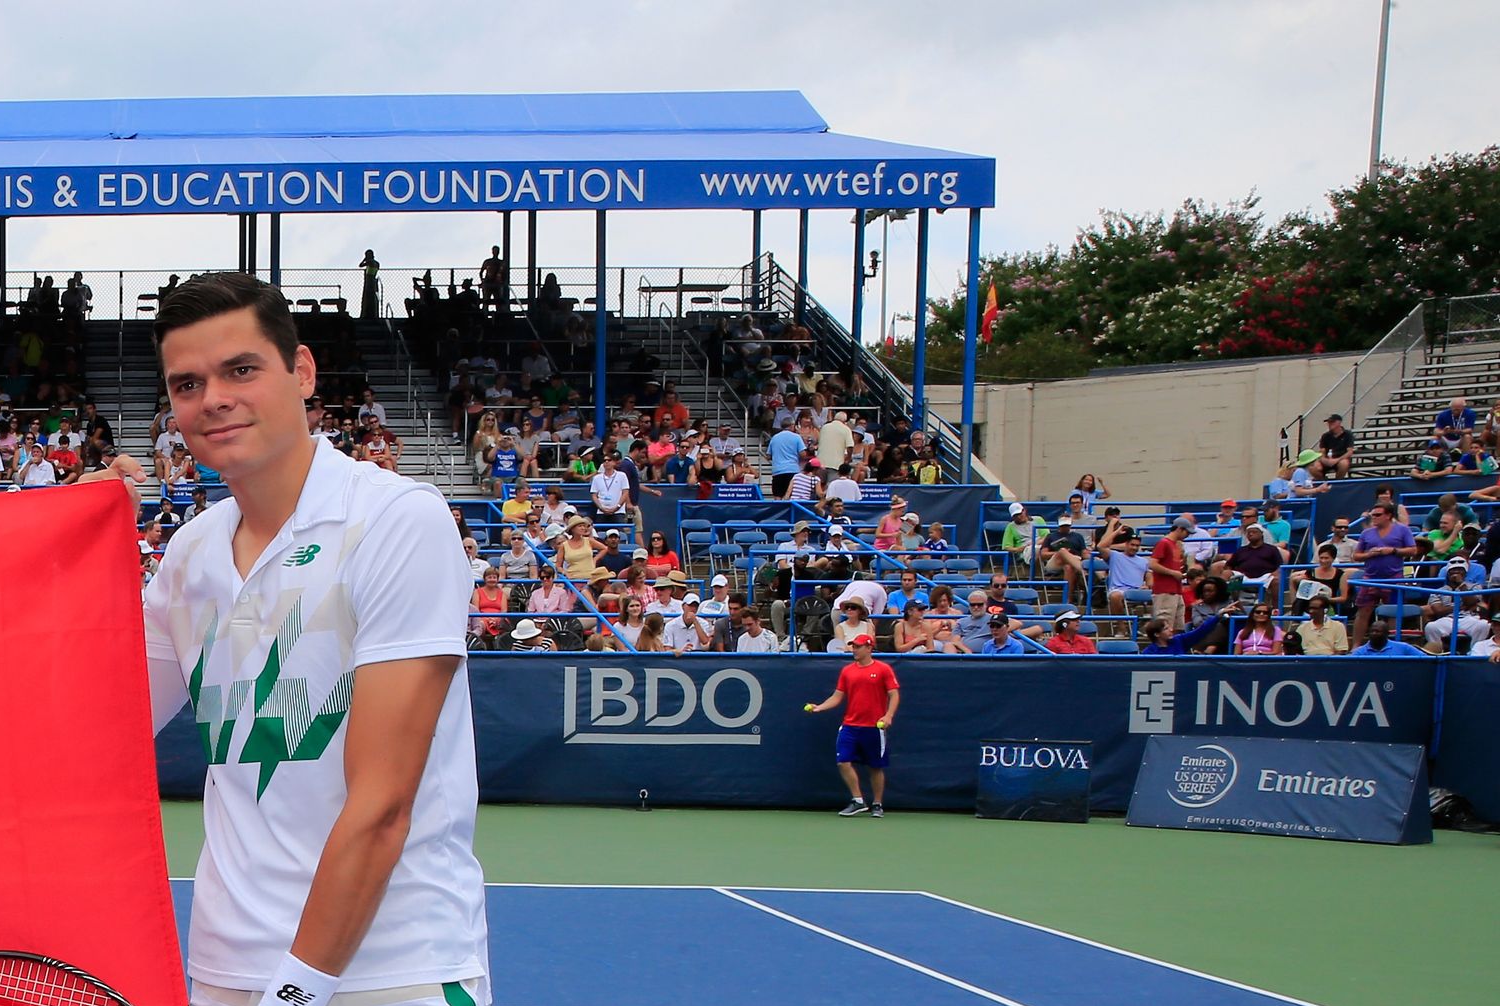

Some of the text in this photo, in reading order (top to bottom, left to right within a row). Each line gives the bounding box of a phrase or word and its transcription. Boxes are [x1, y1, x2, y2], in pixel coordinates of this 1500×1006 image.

[52, 177, 79, 209] &
[98, 170, 346, 207] EDUCATION
[362, 168, 646, 206] FOUNDATION
[700, 162, 959, 205] www.wtef.org
[586, 667, 764, 729] BDO
[1195, 680, 1390, 728] INOVA
[980, 746, 1089, 769] BULOVA
[1181, 756, 1227, 767] Emirates
[1174, 771, 1227, 783] US OPEN
[1177, 782, 1217, 794] SERIES
[1258, 769, 1376, 798] Emirates
